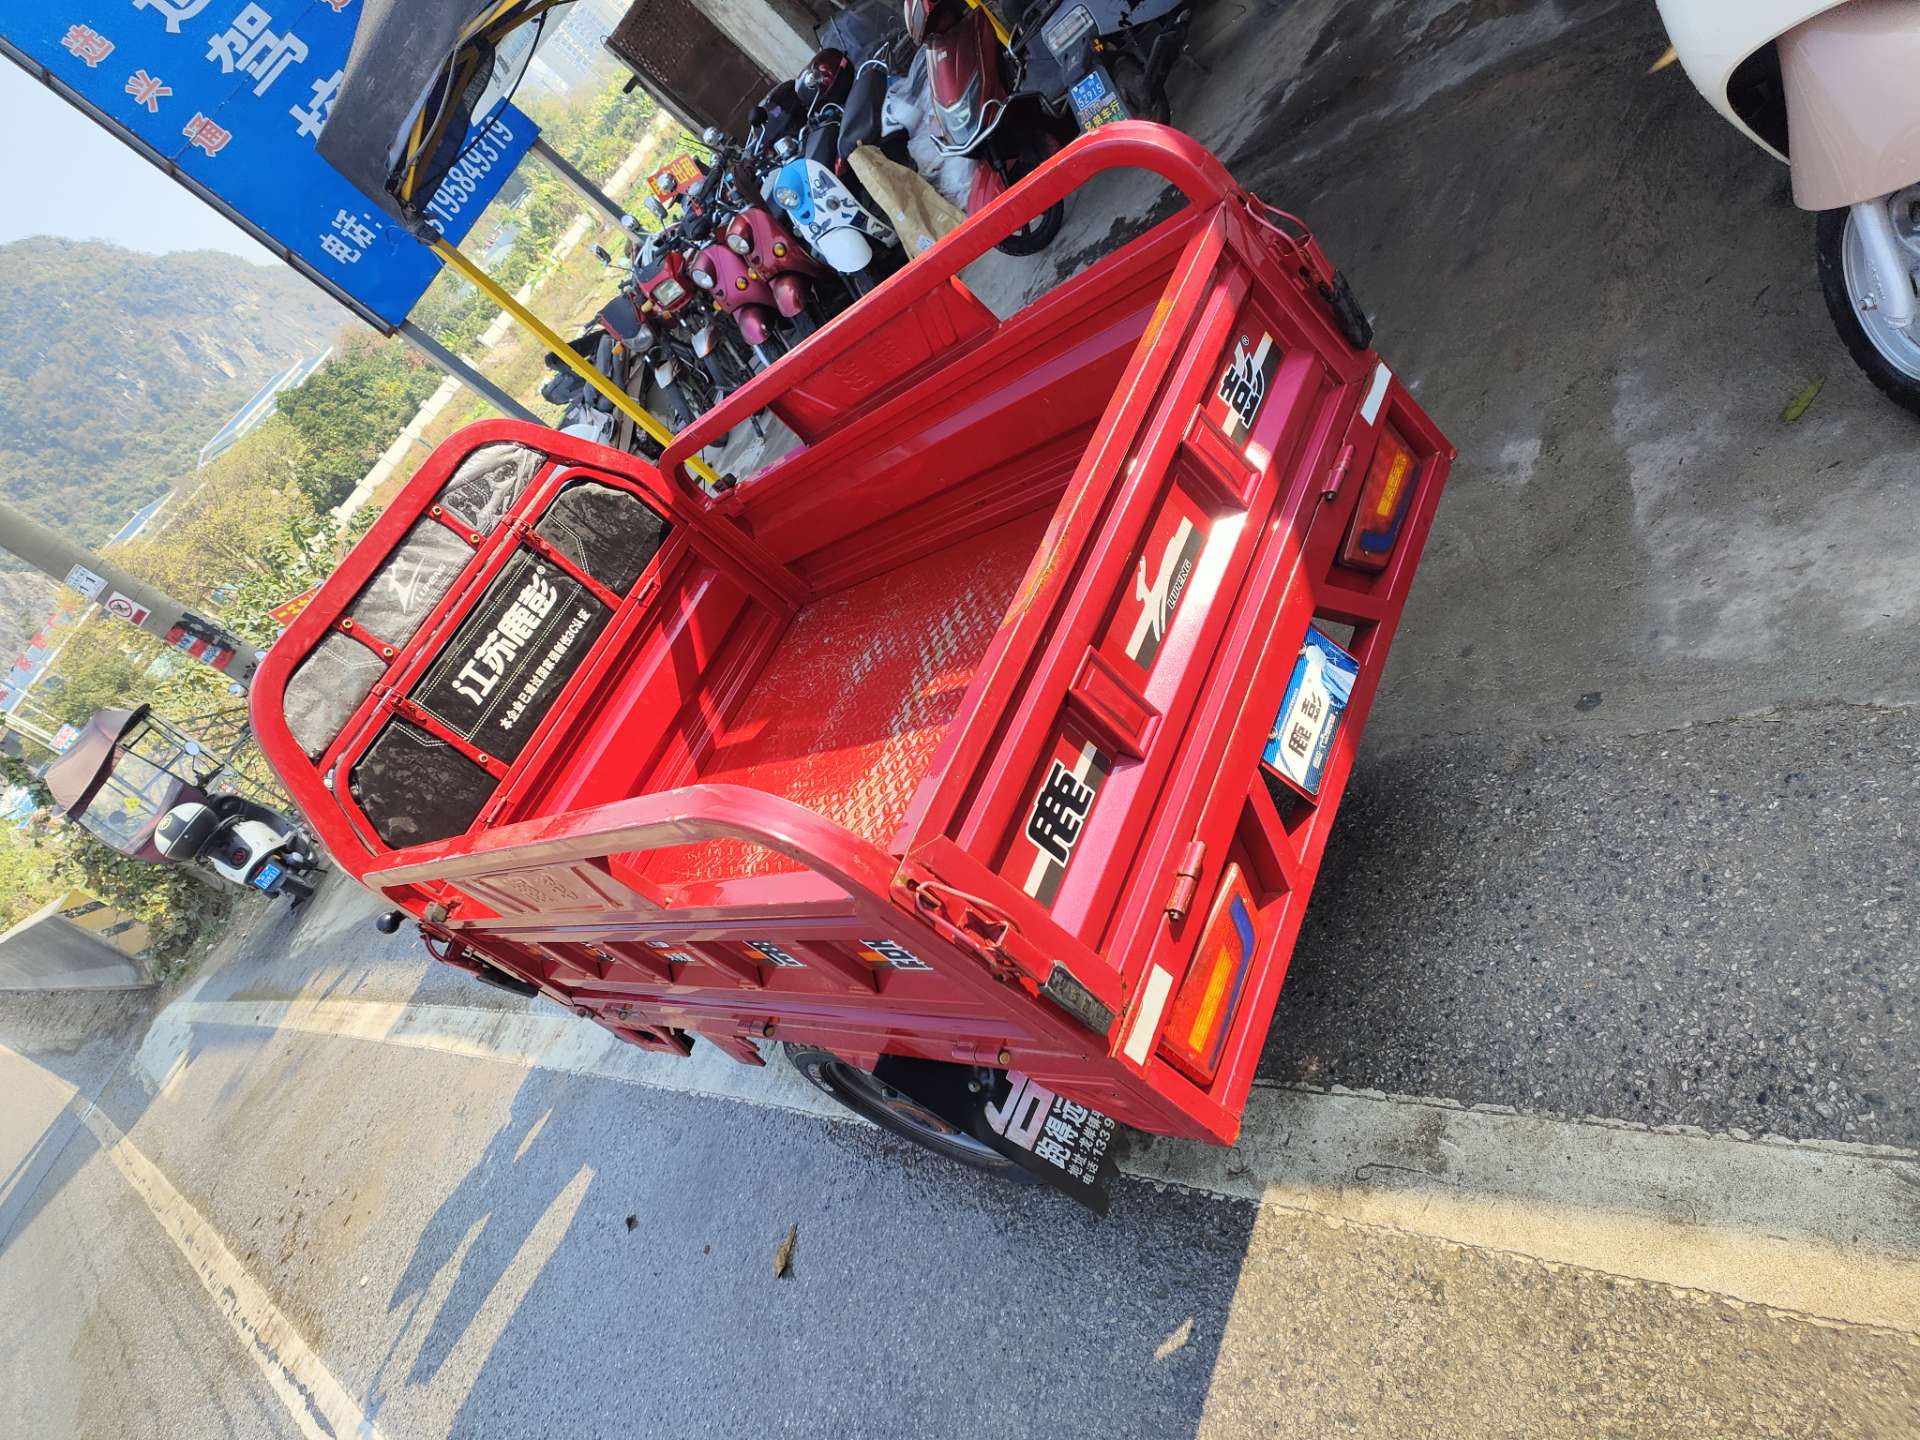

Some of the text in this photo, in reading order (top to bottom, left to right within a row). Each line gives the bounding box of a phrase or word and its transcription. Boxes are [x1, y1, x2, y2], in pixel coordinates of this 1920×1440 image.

[1078, 82, 1103, 107] 52915
[1218, 343, 1264, 429] 彭
[451, 572, 558, 706] 江苏鹿彭
[1026, 759, 1096, 868] 鹿
[1034, 1096, 1089, 1170] 跑得远
